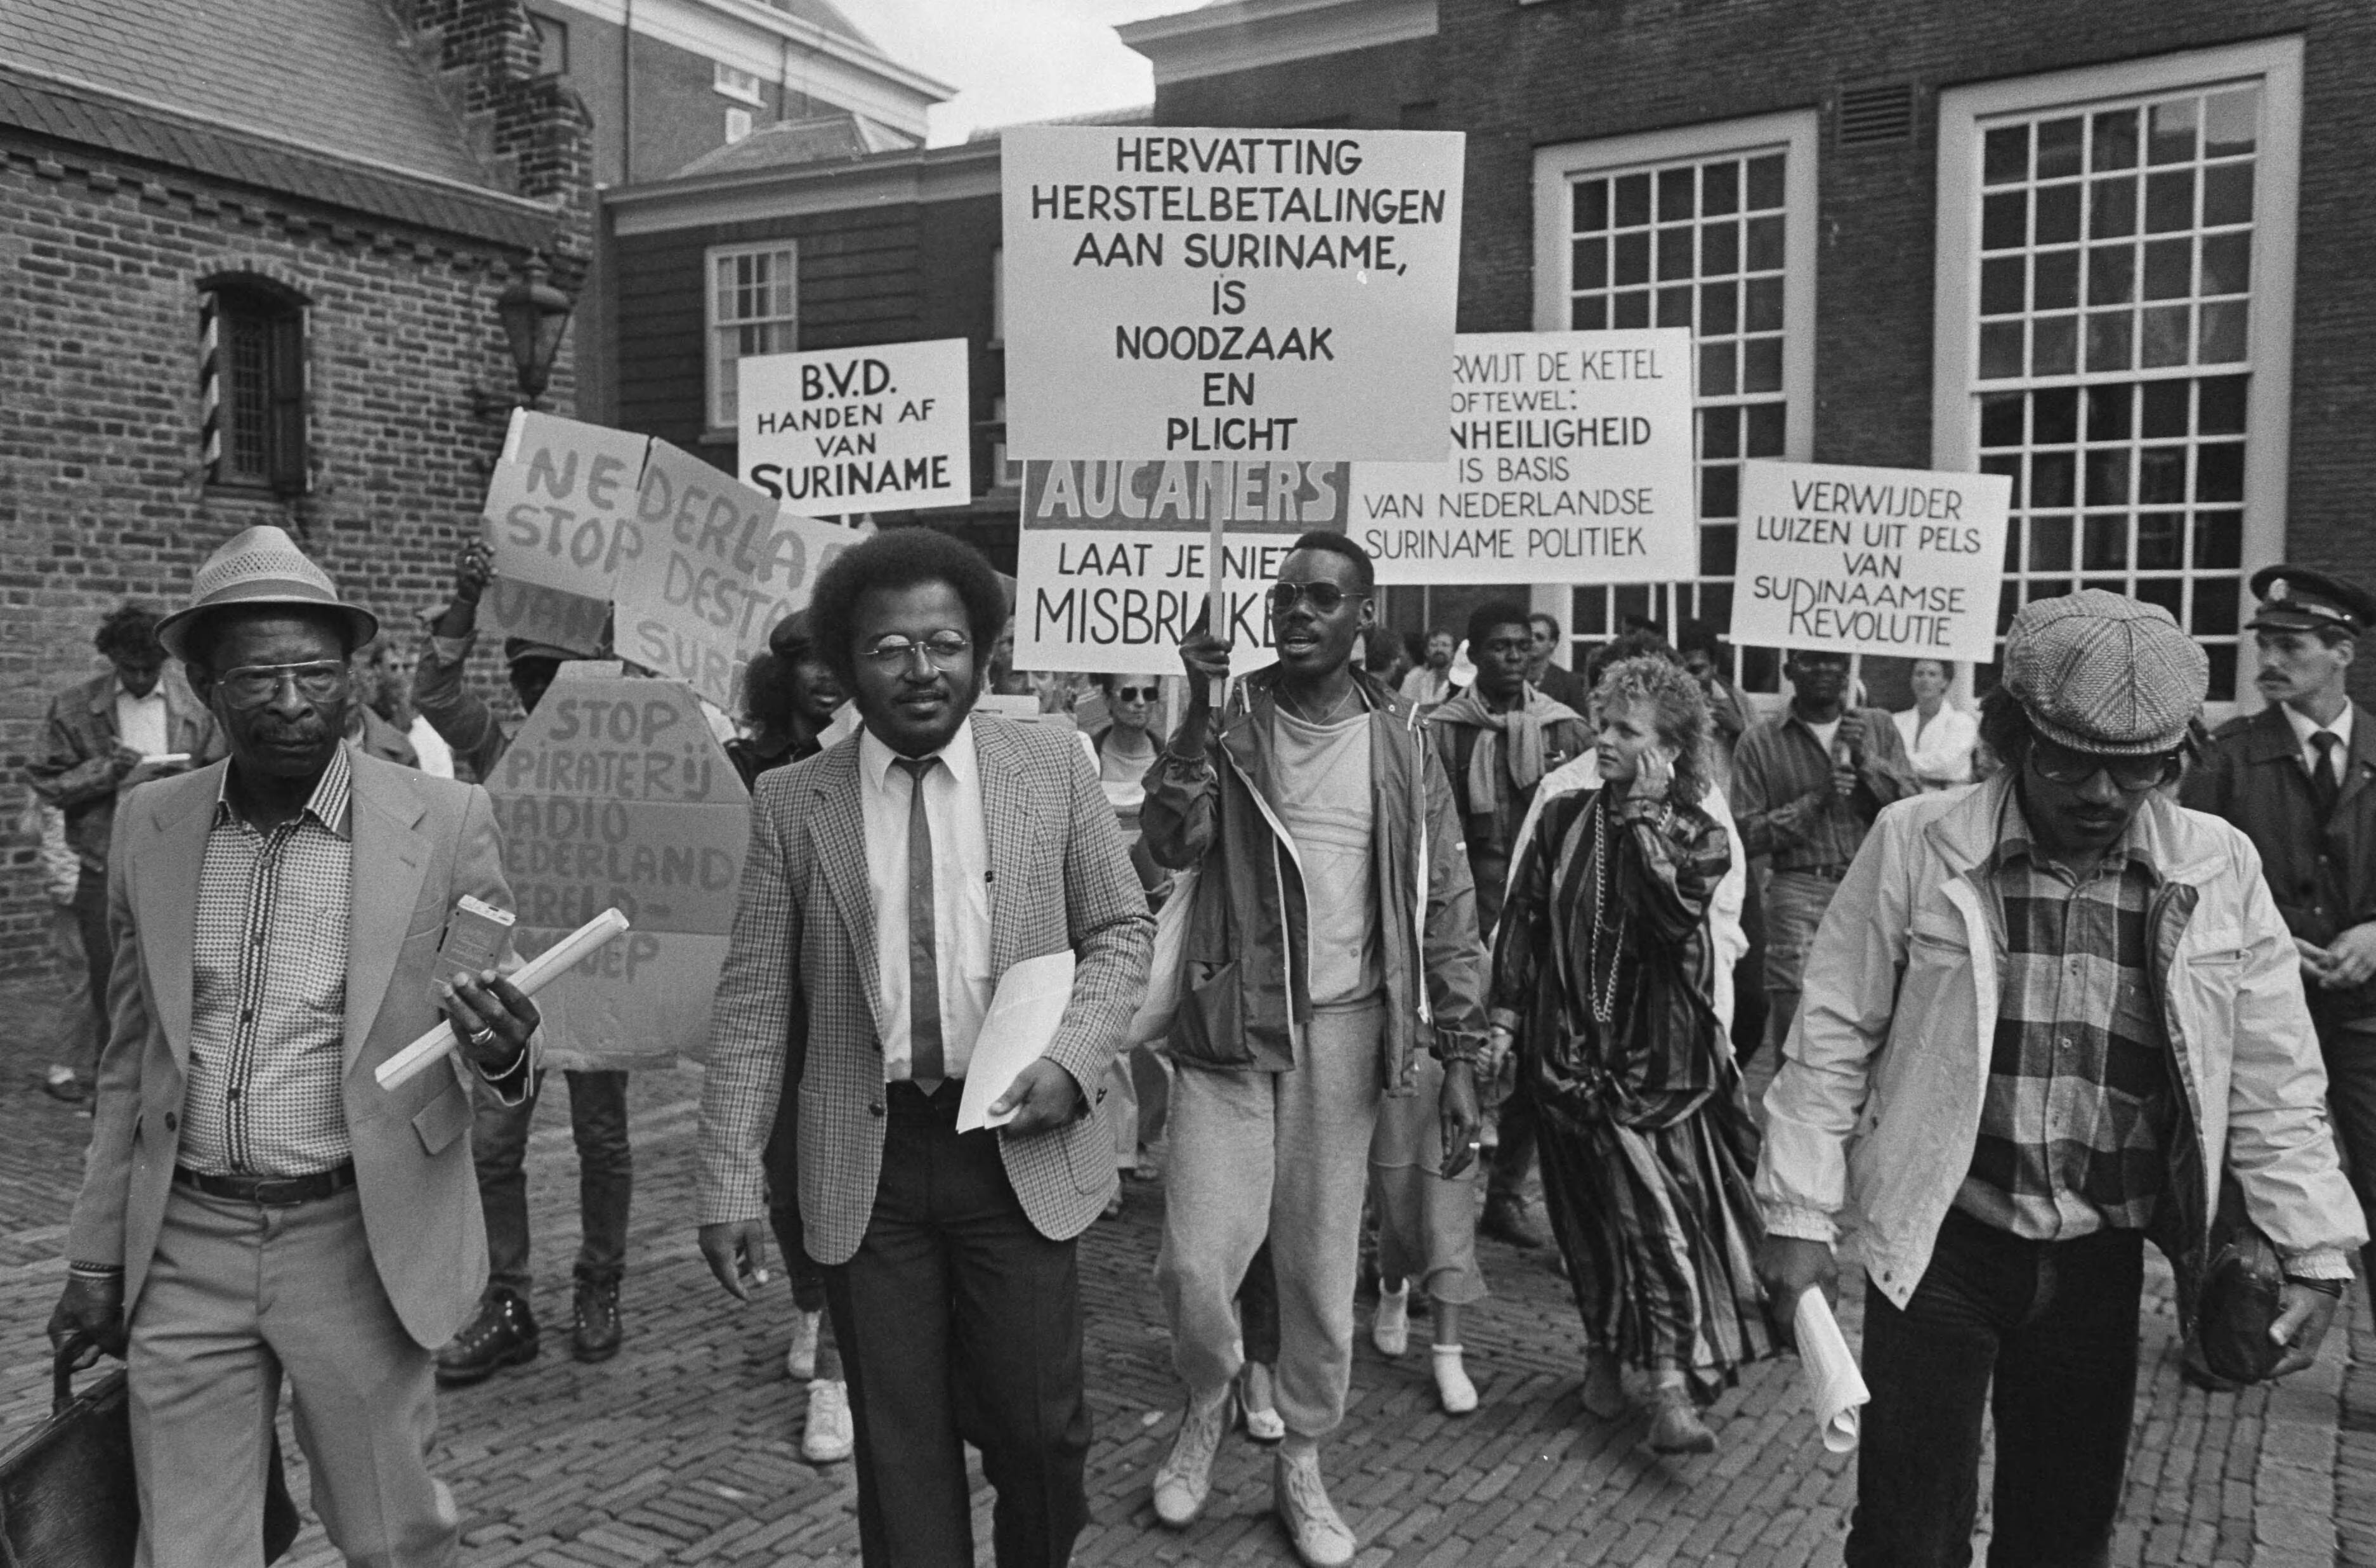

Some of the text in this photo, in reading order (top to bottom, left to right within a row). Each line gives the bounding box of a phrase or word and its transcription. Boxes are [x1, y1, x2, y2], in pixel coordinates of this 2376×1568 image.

[1117, 137, 1362, 176] HERVATTING
[1031, 185, 1446, 225] HERSTELBETALINGEN
[1073, 232, 1408, 277] AAN SURINAME,
[1115, 325, 1334, 361] NOODZAAK
[801, 358, 897, 402] B.V.D.
[1539, 351, 1570, 382] DE
[1582, 348, 1664, 381] KETEL
[1203, 372, 1254, 407] EN
[758, 398, 935, 435] HANDEN AF
[1167, 417, 1297, 451] PLICHT
[815, 433, 876, 459] VAN
[751, 455, 952, 501] SURINAME
[1459, 456, 1570, 483] IS BASIS
[1364, 488, 1655, 519] VAN NEDERLANDSE
[1792, 480, 1962, 520] VERWIJDER
[506, 504, 643, 575] STOP
[1363, 526, 1647, 559] SURINAME POLITIEK
[1757, 516, 1981, 554] LUIZEN UIT PELS
[1058, 543, 1152, 577] LAAT
[1165, 544, 1204, 578] JE
[1843, 551, 1901, 579] VAN
[549, 700, 679, 745] STOP
